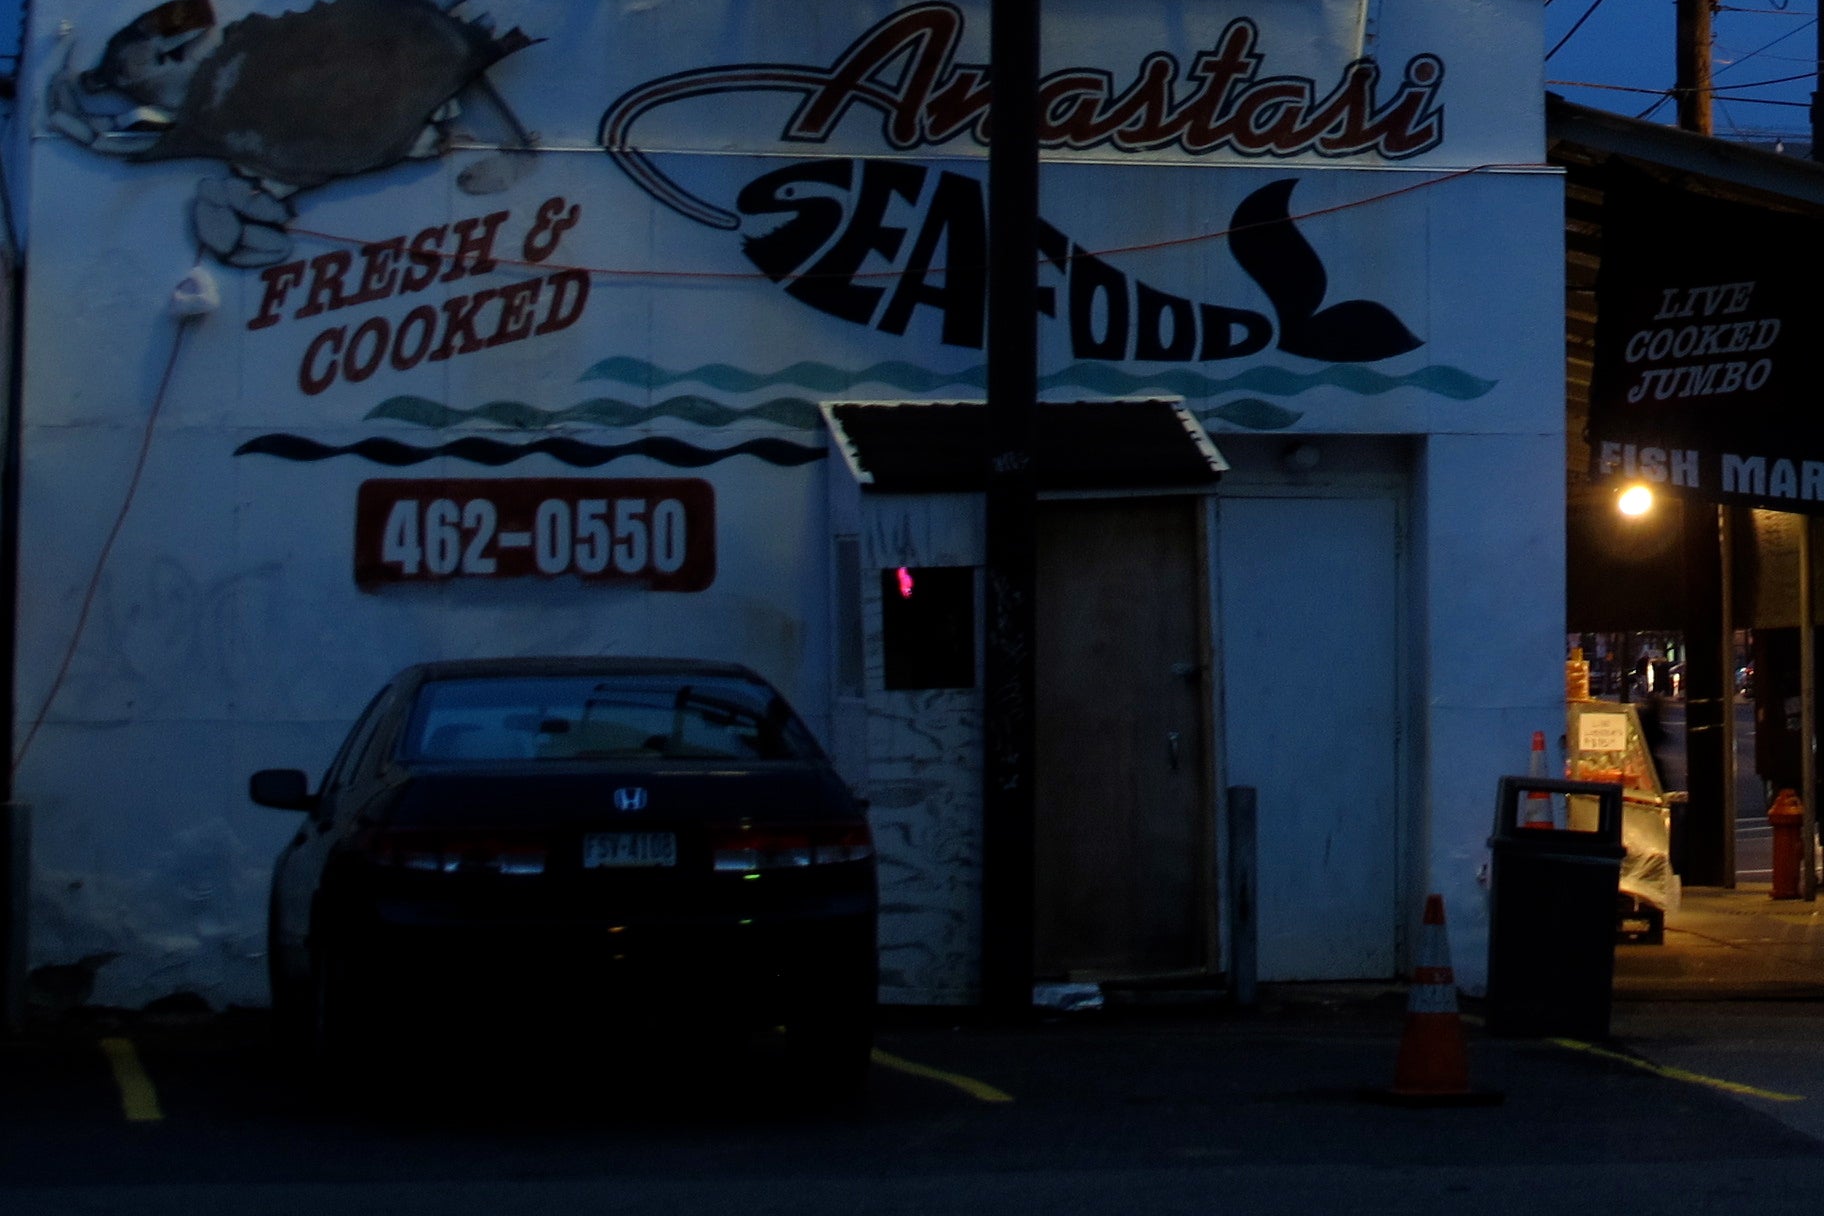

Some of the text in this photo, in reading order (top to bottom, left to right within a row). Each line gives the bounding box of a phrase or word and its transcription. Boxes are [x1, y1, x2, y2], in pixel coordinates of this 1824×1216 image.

[782, 0, 1445, 161] Anastasi
[248, 196, 580, 330] FRESH &
[298, 267, 591, 395] COOKED
[1653, 280, 1758, 321] LIVE
[1624, 317, 1784, 364] COOKED
[1626, 357, 1774, 404] JUMBO
[1598, 440, 1701, 488] FISH
[381, 496, 689, 575] 462-0550
